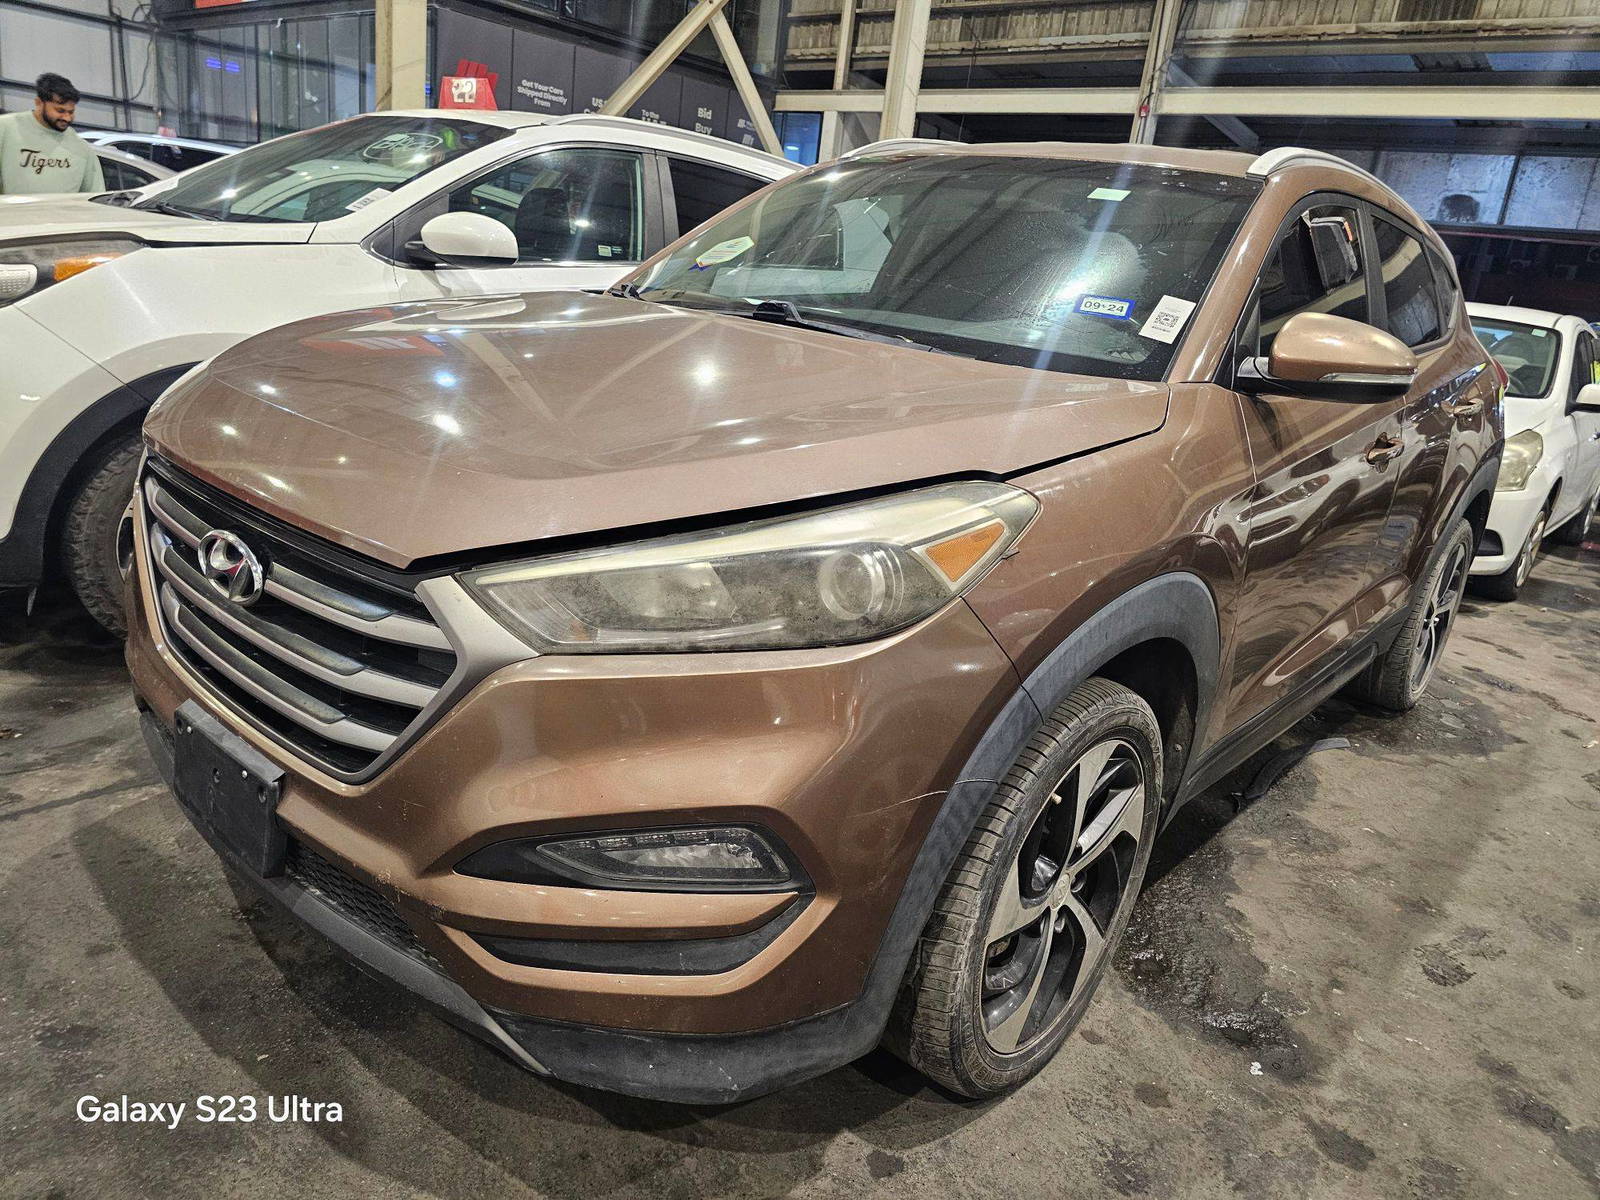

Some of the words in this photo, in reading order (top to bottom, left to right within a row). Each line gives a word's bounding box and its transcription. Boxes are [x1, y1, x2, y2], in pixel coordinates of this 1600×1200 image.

[521, 79, 534, 89] Get
[534, 81, 548, 92] Your
[548, 86, 563, 96] Cars
[517, 86, 543, 99] Shipped
[543, 92, 568, 105] Directly
[534, 98, 551, 108] From
[591, 97, 607, 108] US
[641, 109, 650, 118] To
[698, 107, 712, 120] Bid
[695, 123, 712, 135] Buy
[20, 149, 71, 174] Tigers
